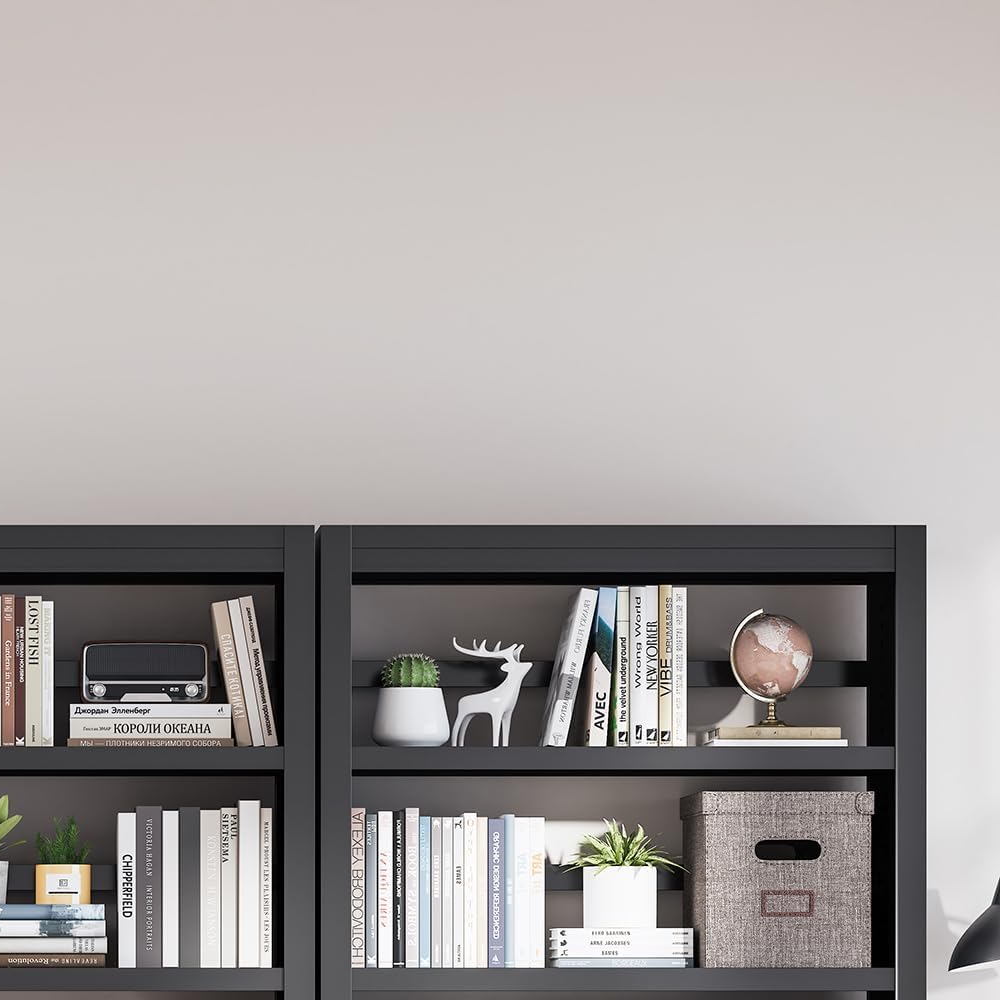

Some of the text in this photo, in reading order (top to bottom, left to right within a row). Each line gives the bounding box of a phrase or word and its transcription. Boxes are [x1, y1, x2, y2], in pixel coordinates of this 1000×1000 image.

[4, 640, 12, 670] Gardens
[28, 599, 40, 666] LOST FISH
[646, 620, 658, 690] NEW YORKER
[660, 597, 673, 697] VIBE DRUM&BASS
[4, 681, 12, 707] France
[221, 633, 245, 720] СПАСИТЕ КОТИКА!
[619, 636, 628, 723] the velvet underground
[74, 706, 151, 715] Джордан Элленберг
[113, 723, 161, 734] КОРОЛИ
[163, 723, 212, 734] ОКЕАНА
[594, 691, 607, 730] AVEC
[122, 854, 133, 918] CHIPPERFIELD
